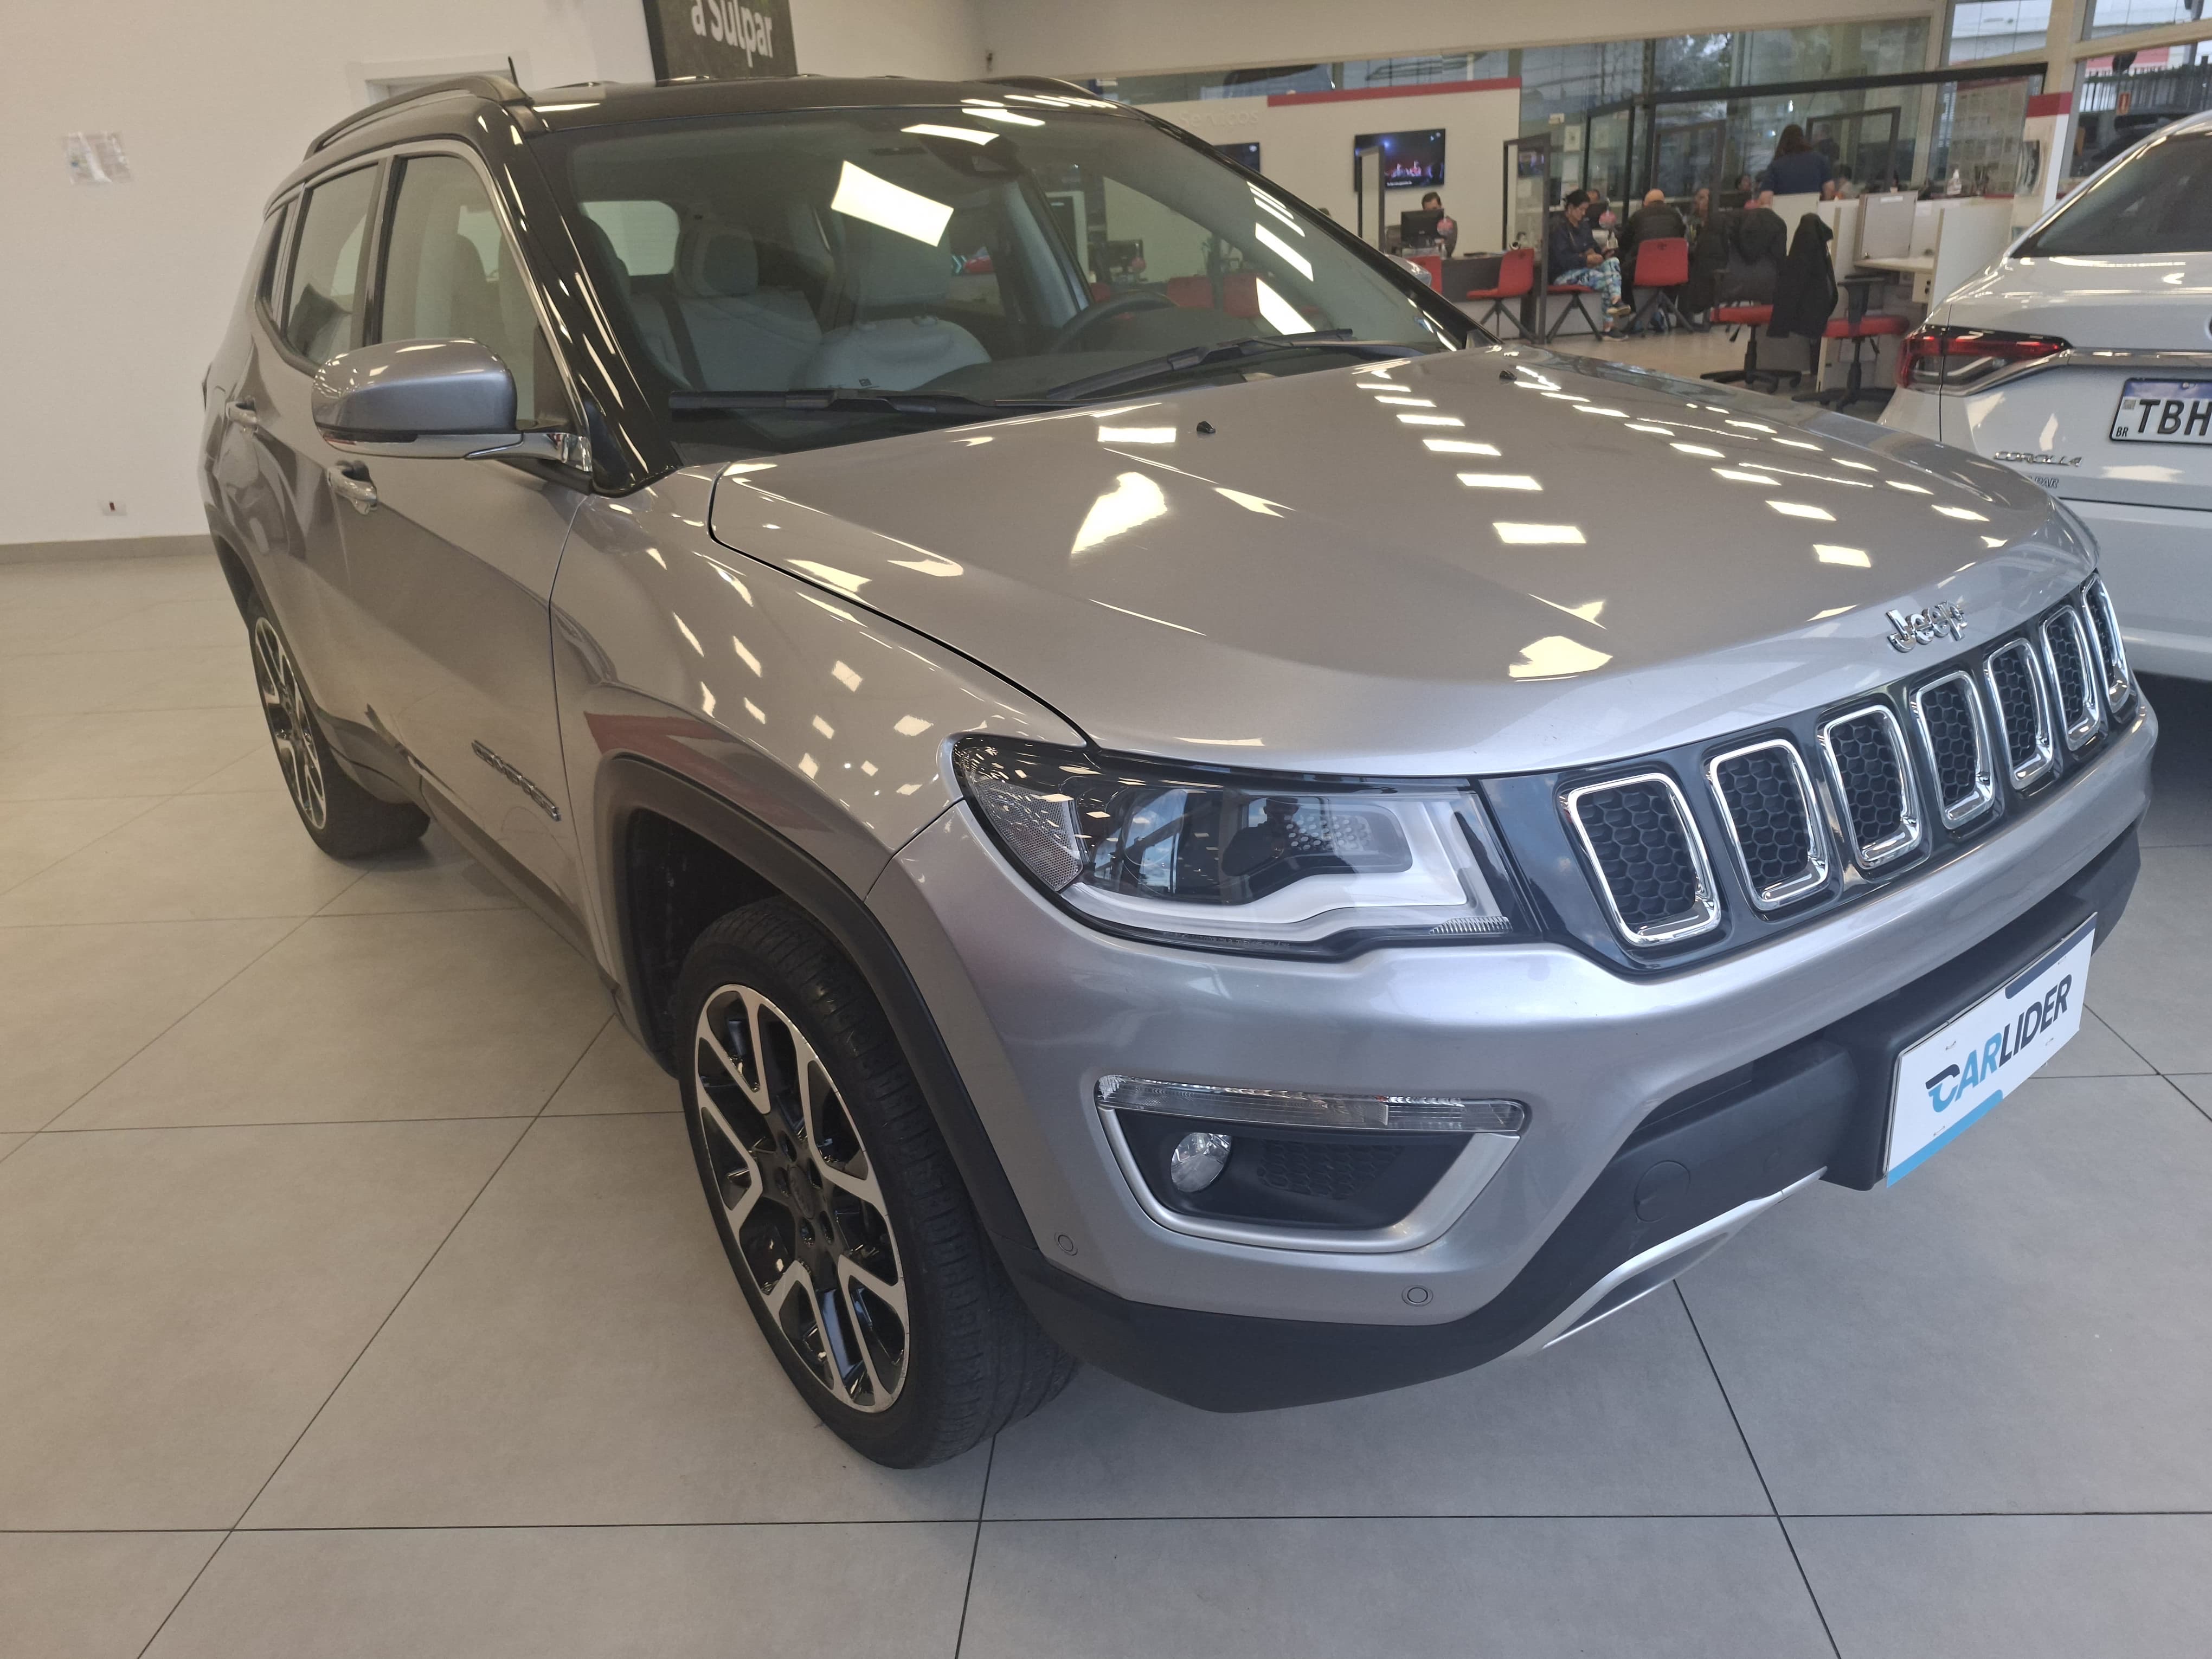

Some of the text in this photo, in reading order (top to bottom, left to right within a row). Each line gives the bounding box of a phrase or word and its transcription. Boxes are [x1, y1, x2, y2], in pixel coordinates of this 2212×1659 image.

[691, 0, 774, 68] a Sulpar
[2115, 426, 2129, 438] BR
[2138, 398, 2212, 436] TBH
[1994, 451, 2082, 467] COROLLA
[1886, 600, 1967, 653] Jeep
[1925, 974, 2073, 1113] CARLIDER
